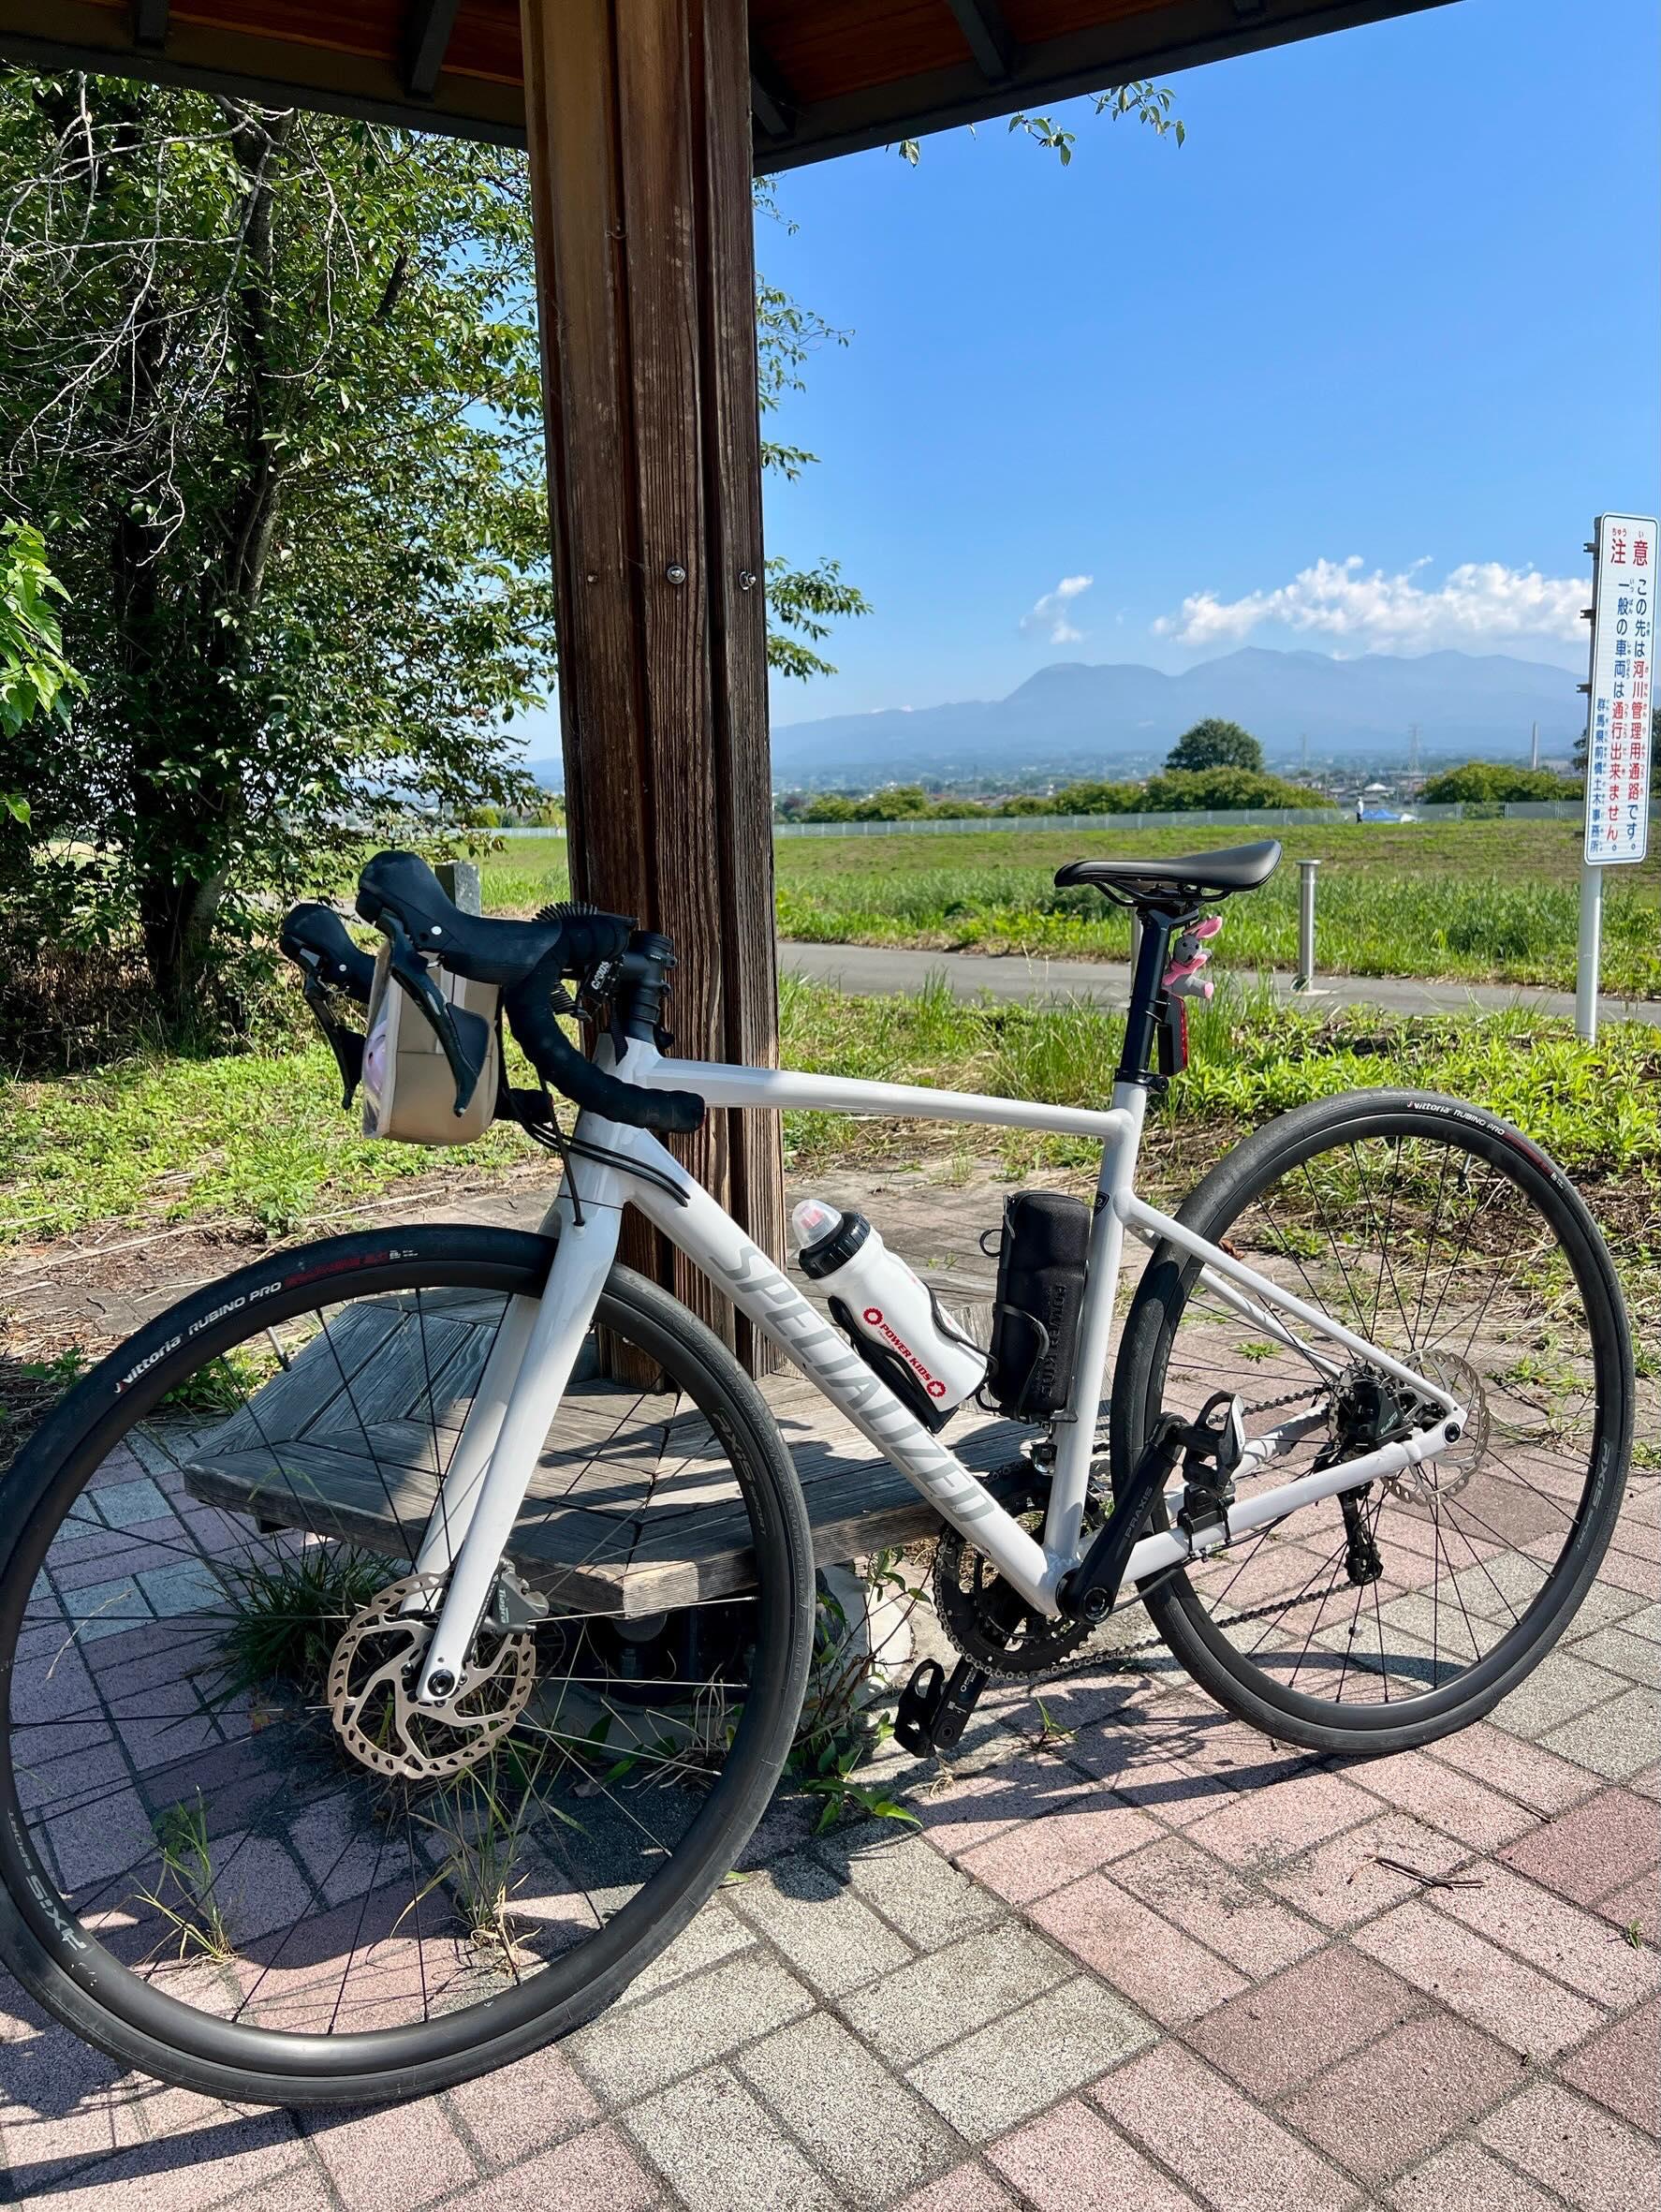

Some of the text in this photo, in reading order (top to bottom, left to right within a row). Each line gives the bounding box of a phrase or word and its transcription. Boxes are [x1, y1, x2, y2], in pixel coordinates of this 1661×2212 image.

[1610, 538, 1648, 567] 注意
[1607, 582, 1629, 851] 一般の車両は通行出来ません。
[1626, 579, 1647, 850] この先は河川管理用通路です。
[188, 1295, 246, 1336] RUBINO
[249, 1281, 282, 1303] PRO
[879, 1322, 912, 1360] POWER
[909, 1353, 933, 1382] KIDS
[709, 1246, 994, 1523] SPECIALIZED
[1124, 1485, 1154, 1538] PRAXIS
